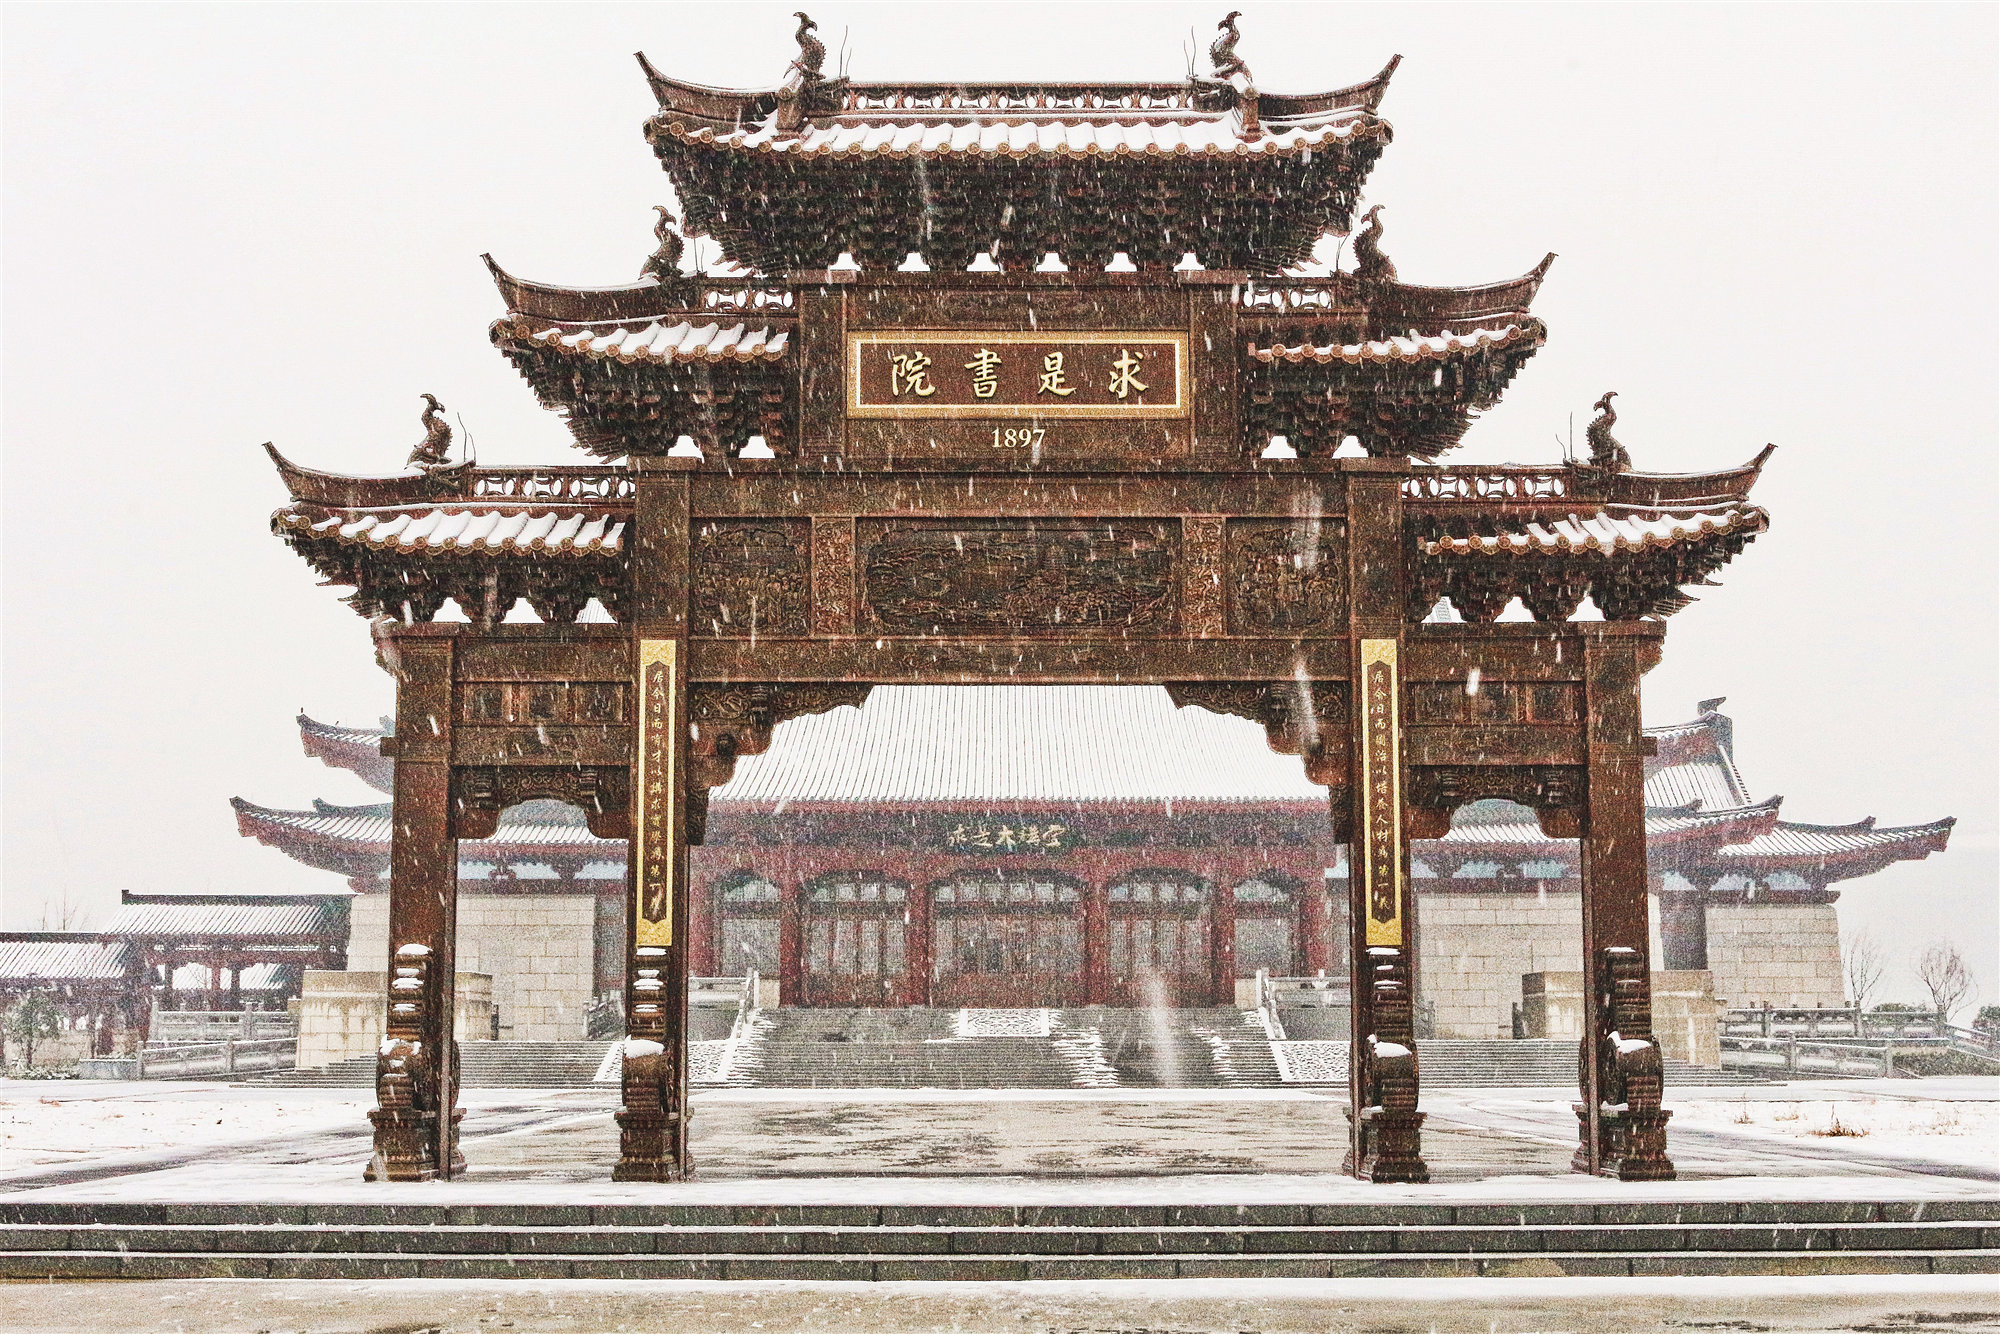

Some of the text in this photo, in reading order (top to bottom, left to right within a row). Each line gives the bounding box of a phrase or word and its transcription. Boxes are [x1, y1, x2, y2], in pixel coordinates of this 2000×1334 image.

[891, 348, 1149, 399] 求是書院
[991, 427, 1046, 448] 1897
